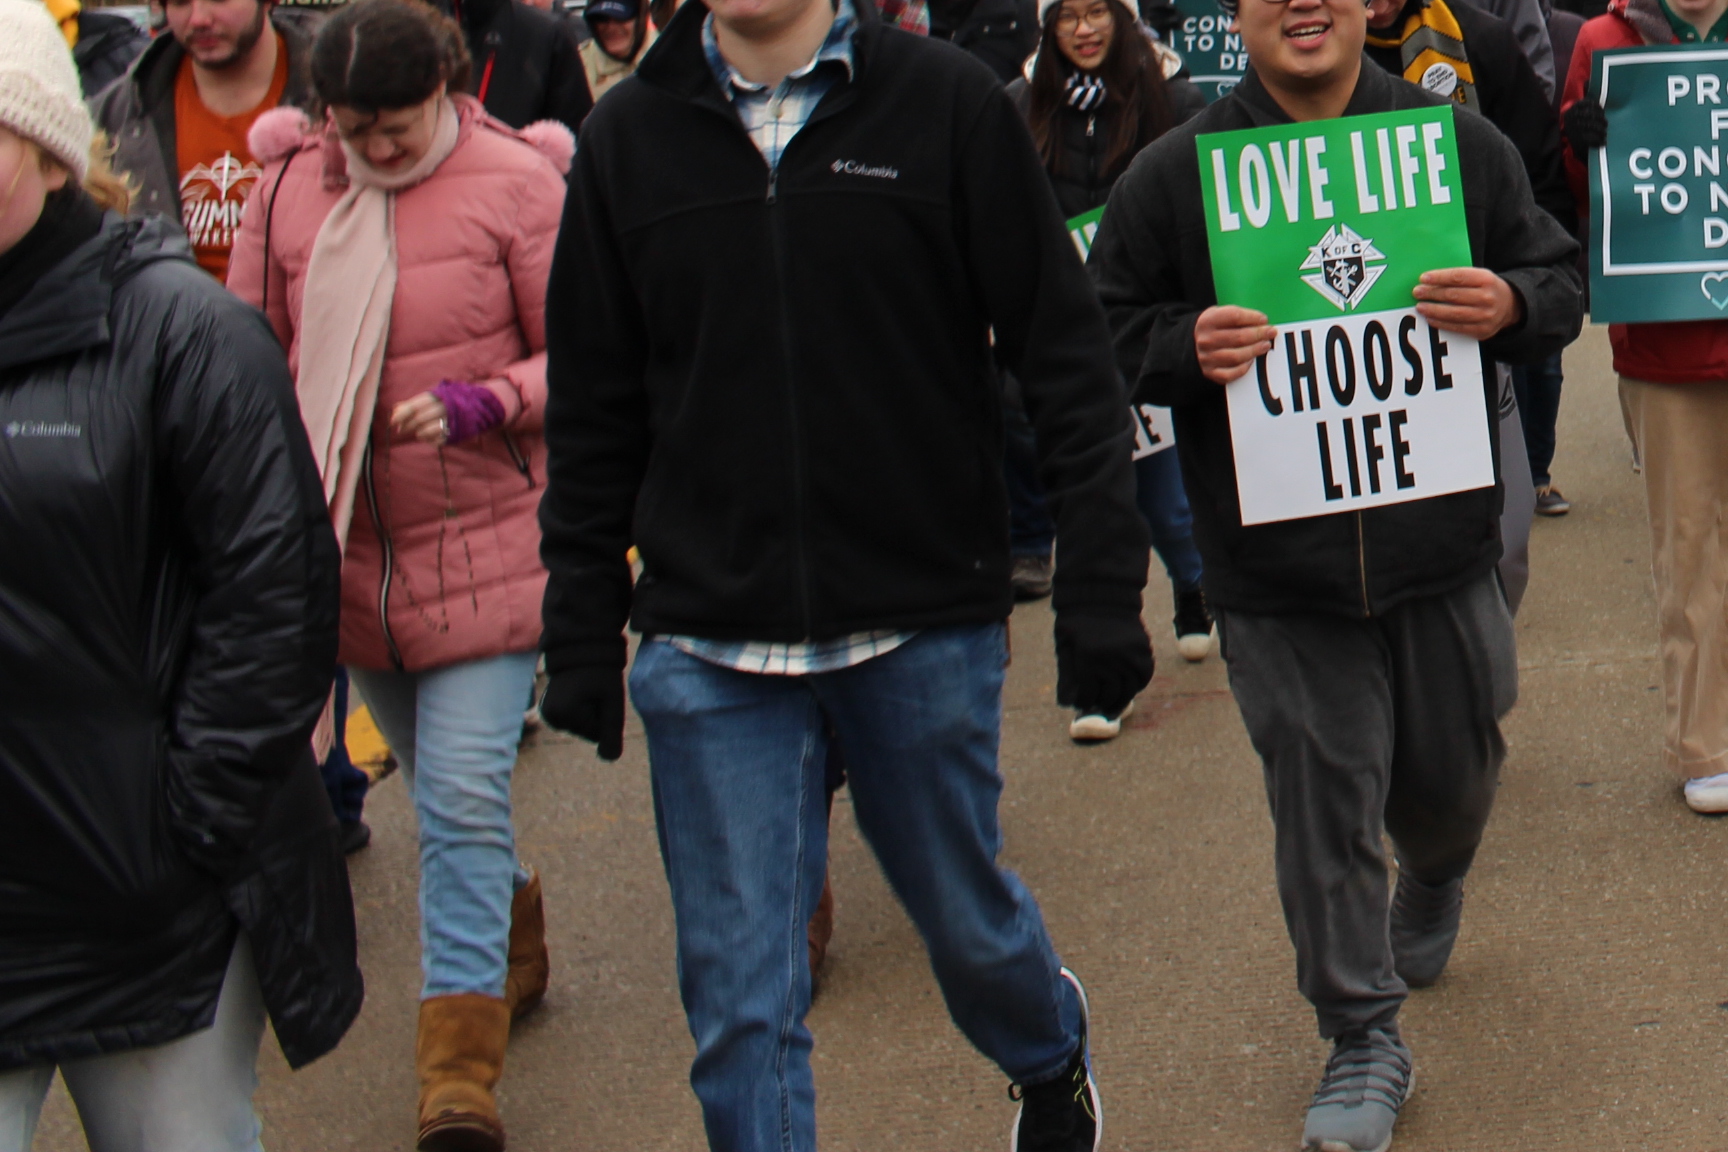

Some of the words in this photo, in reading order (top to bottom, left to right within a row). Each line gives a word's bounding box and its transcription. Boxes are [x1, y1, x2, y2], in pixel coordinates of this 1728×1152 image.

[1183, 34, 1214, 53] TO
[844, 160, 898, 179] Columbia
[1211, 135, 1334, 232] LOVE
[1350, 122, 1451, 214] LIFE
[1634, 182, 1689, 215] TO
[1321, 246, 1332, 258] K
[1351, 243, 1362, 254] C
[1256, 314, 1454, 417] CHOOSE
[20, 420, 81, 438] Columbia
[1316, 409, 1416, 502] LIFE
